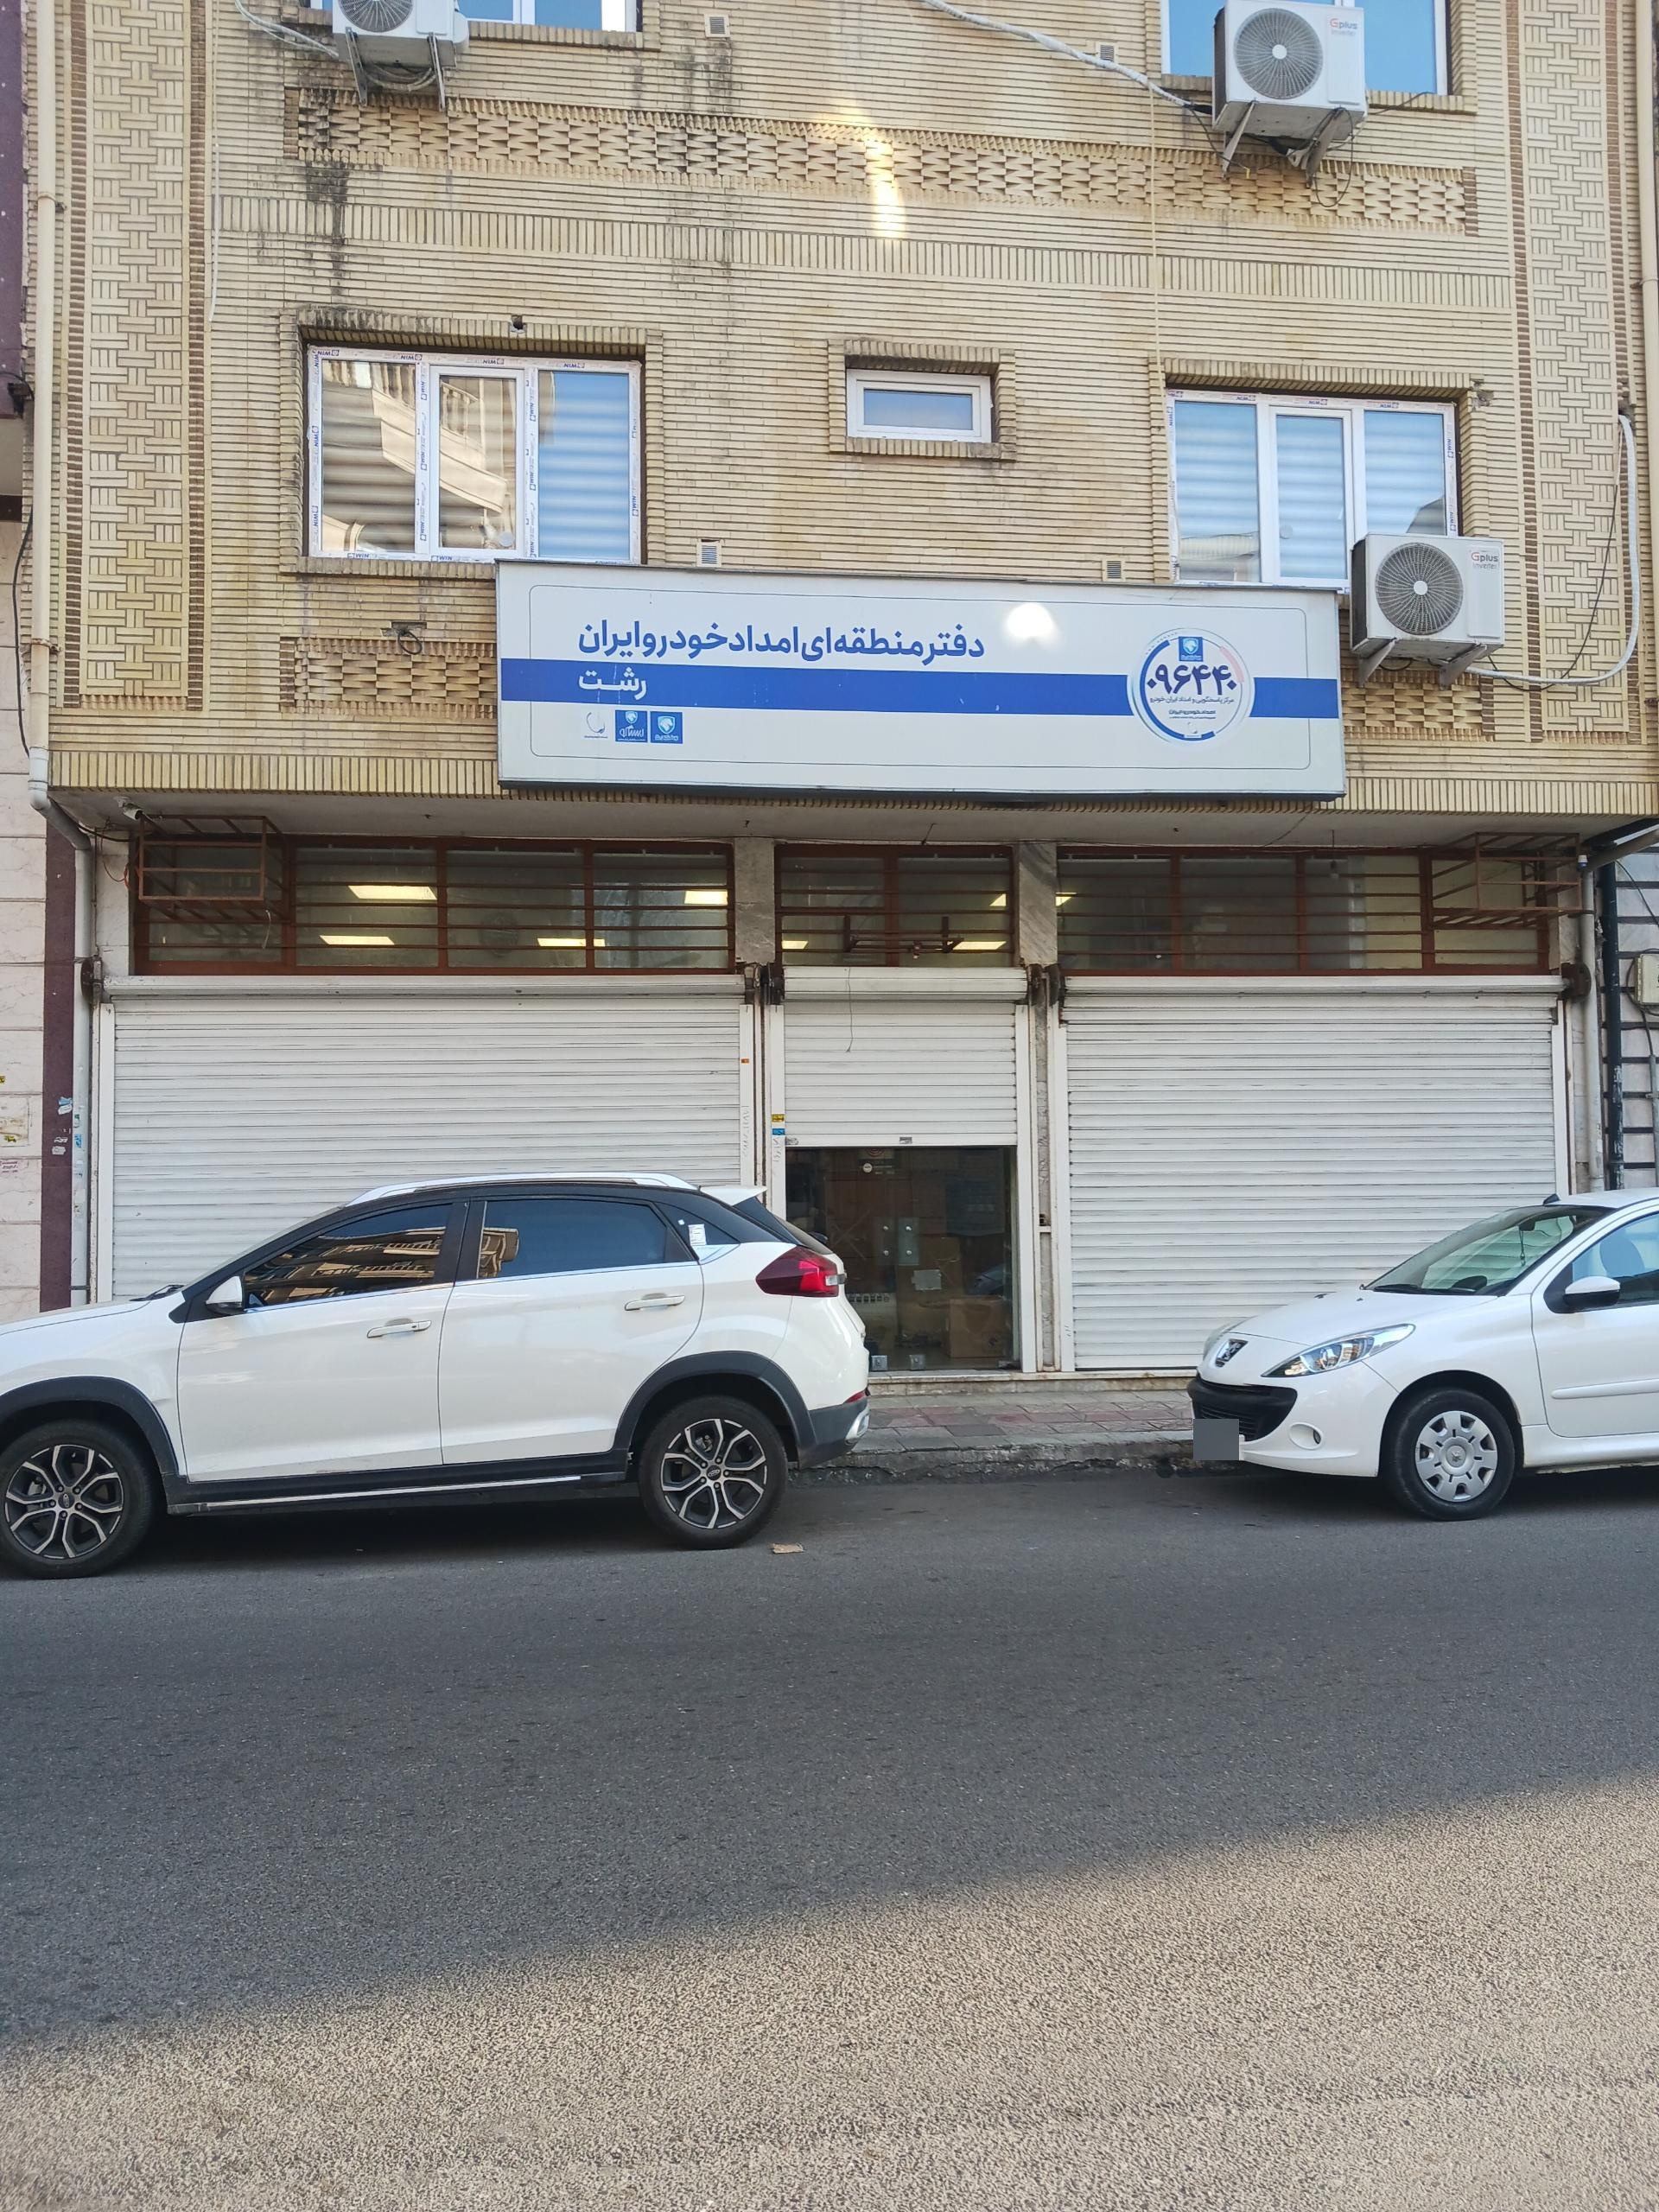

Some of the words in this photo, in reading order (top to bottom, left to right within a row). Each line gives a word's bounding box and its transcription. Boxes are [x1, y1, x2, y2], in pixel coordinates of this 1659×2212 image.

[1471, 552, 1499, 563] Gplus
[579, 620, 640, 658] ایران
[641, 622, 728, 658] خودرو
[728, 625, 798, 653] امداد
[921, 624, 985, 665] دفتر
[578, 667, 647, 701] رشت
